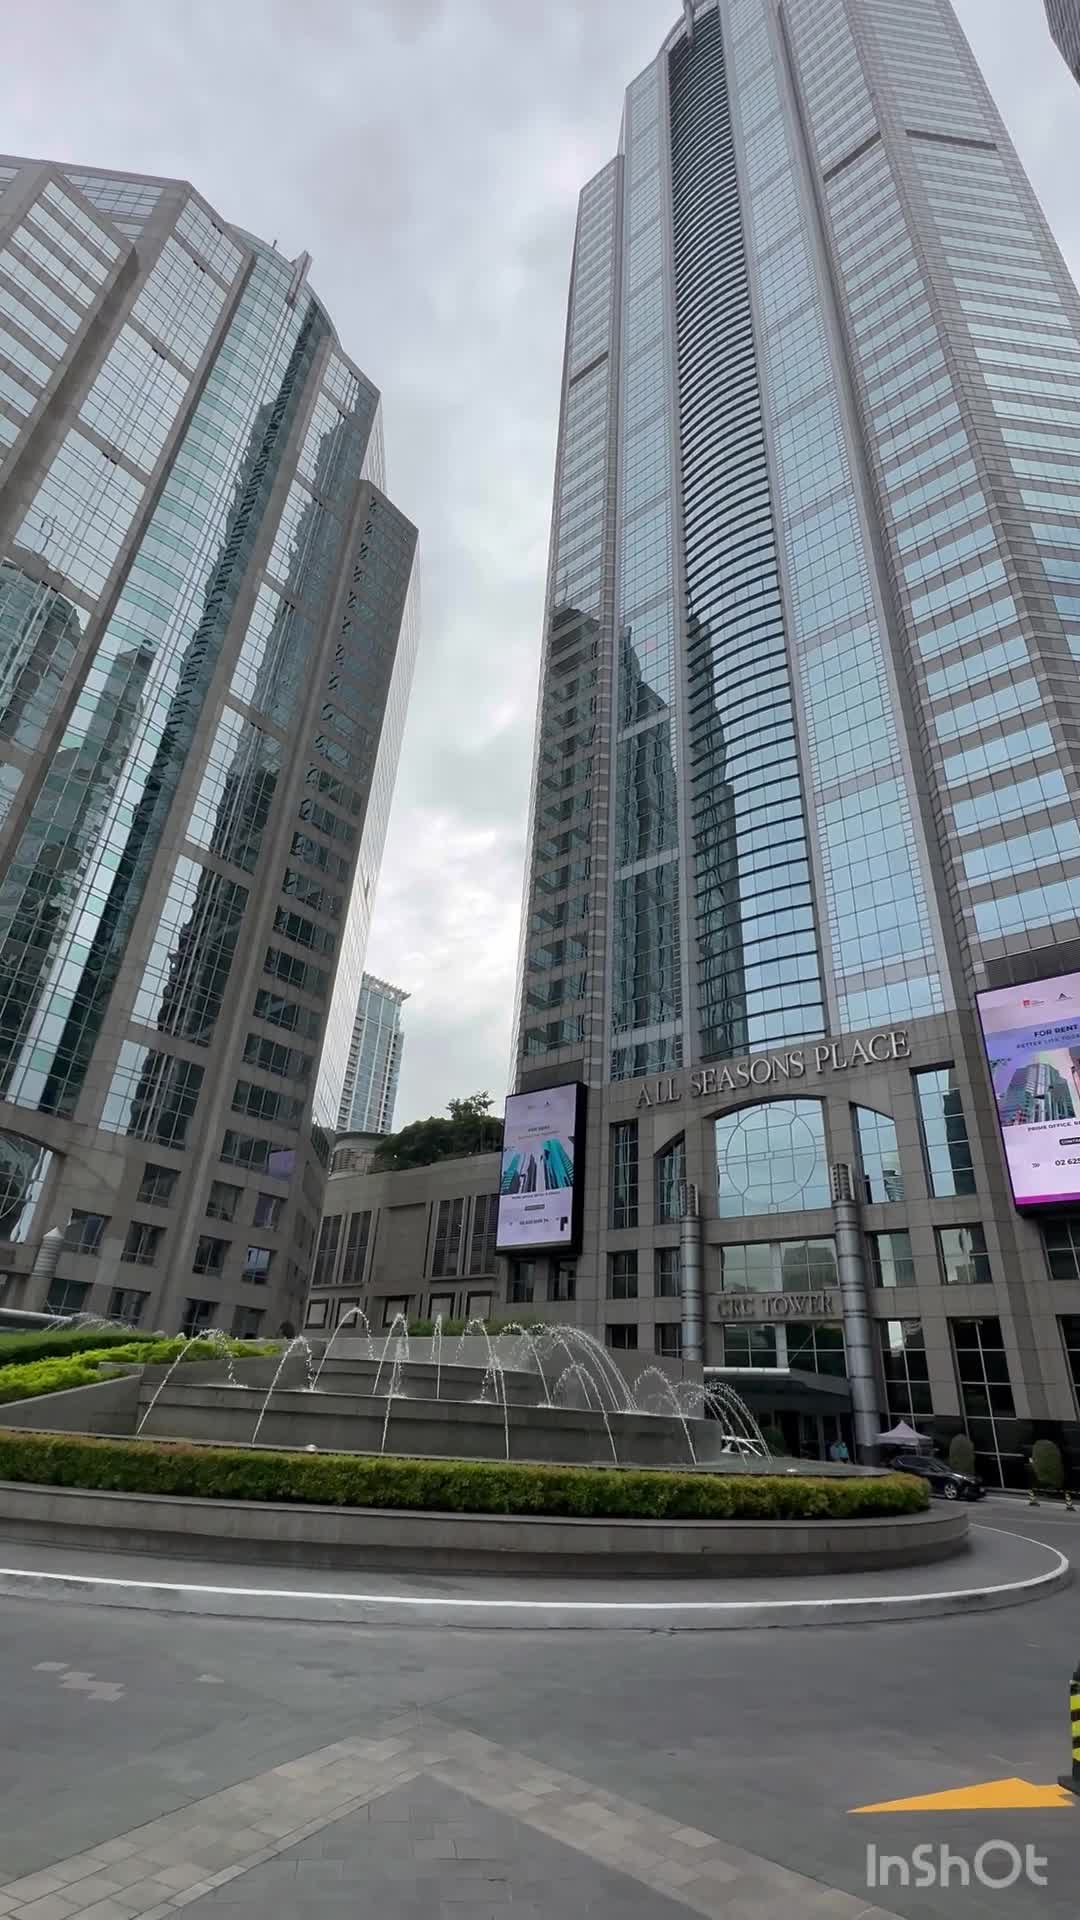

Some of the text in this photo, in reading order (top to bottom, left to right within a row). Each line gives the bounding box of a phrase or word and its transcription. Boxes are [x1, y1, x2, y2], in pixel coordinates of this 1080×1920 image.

[1033, 1024, 1078, 1038] FOR RENT
[635, 1030, 911, 1109] ALL SEASONS PLACE
[1055, 1159, 1066, 1167] 02
[718, 1294, 833, 1318] CRC TOWER
